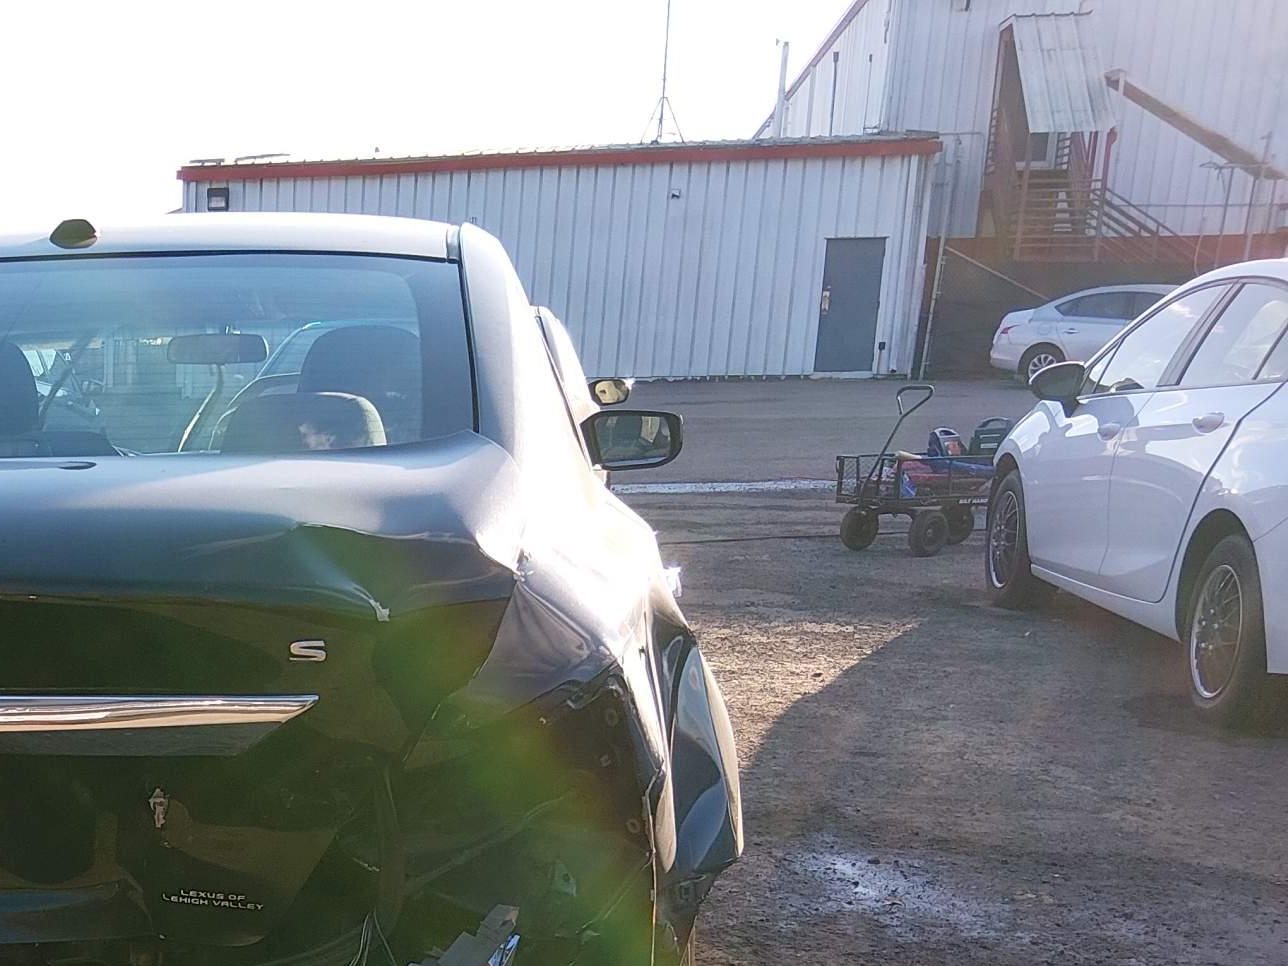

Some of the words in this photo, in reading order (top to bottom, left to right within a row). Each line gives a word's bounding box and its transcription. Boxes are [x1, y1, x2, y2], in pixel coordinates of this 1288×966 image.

[289, 640, 327, 662] S
[162, 893, 208, 905] LEHIGH
[212, 900, 264, 910] VALLEY
[180, 889, 225, 900] LEXUS
